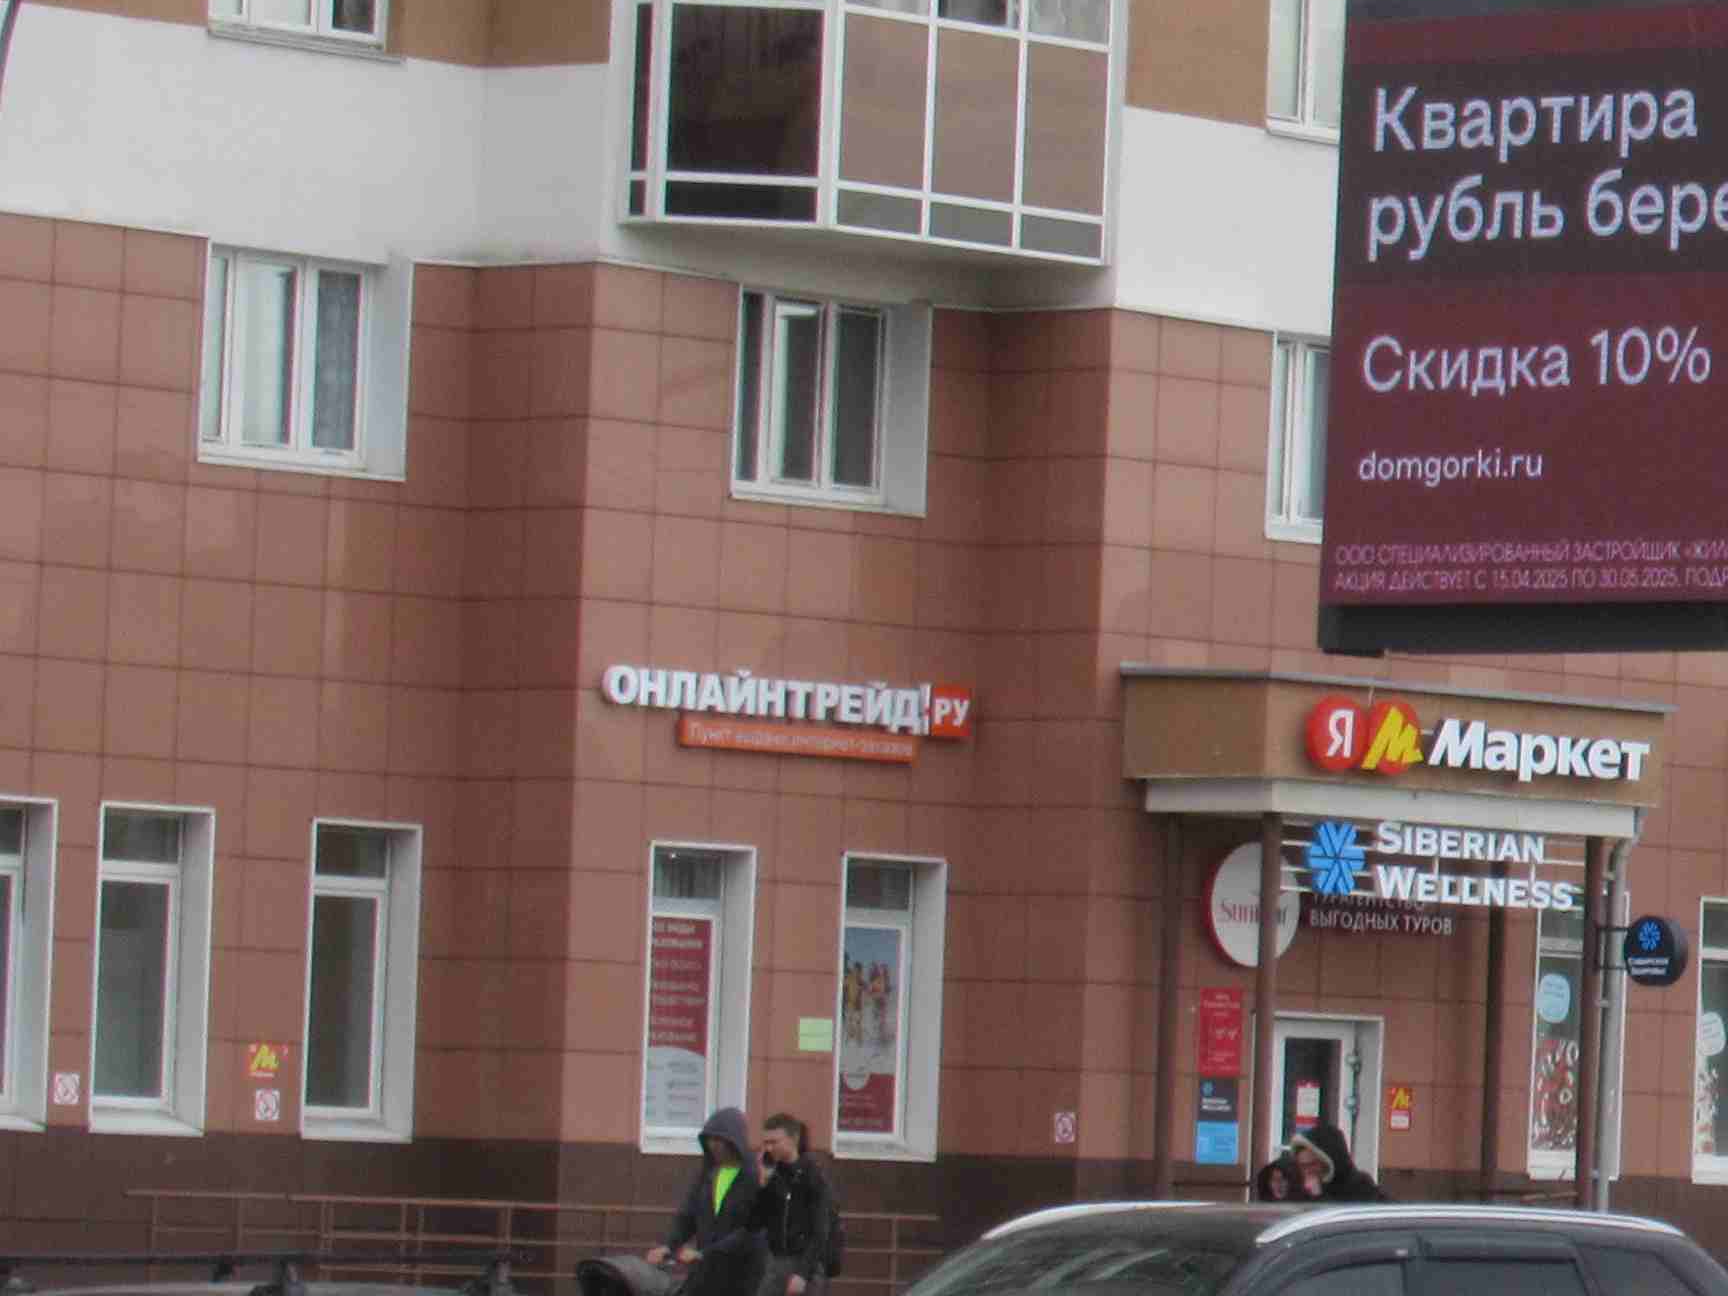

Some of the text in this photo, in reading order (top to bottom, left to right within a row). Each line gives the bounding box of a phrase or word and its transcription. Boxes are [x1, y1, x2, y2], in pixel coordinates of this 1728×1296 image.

[1373, 86, 1699, 163] Квартира
[1367, 174, 1565, 262] рубль
[1363, 326, 1711, 396] Скидка 10%
[1359, 448, 1544, 488] domgorki.ru
[1573, 537, 1681, 561] ЗАСТРОЙЩИК
[1327, 708, 1355, 758] Я
[1428, 718, 1650, 782] Маркет
[1376, 821, 1546, 864] SIBERIAN
[1376, 865, 1575, 910] WELLNESS
[1310, 909, 1453, 935] ВЫГОДНЫХ ТУРОВ
